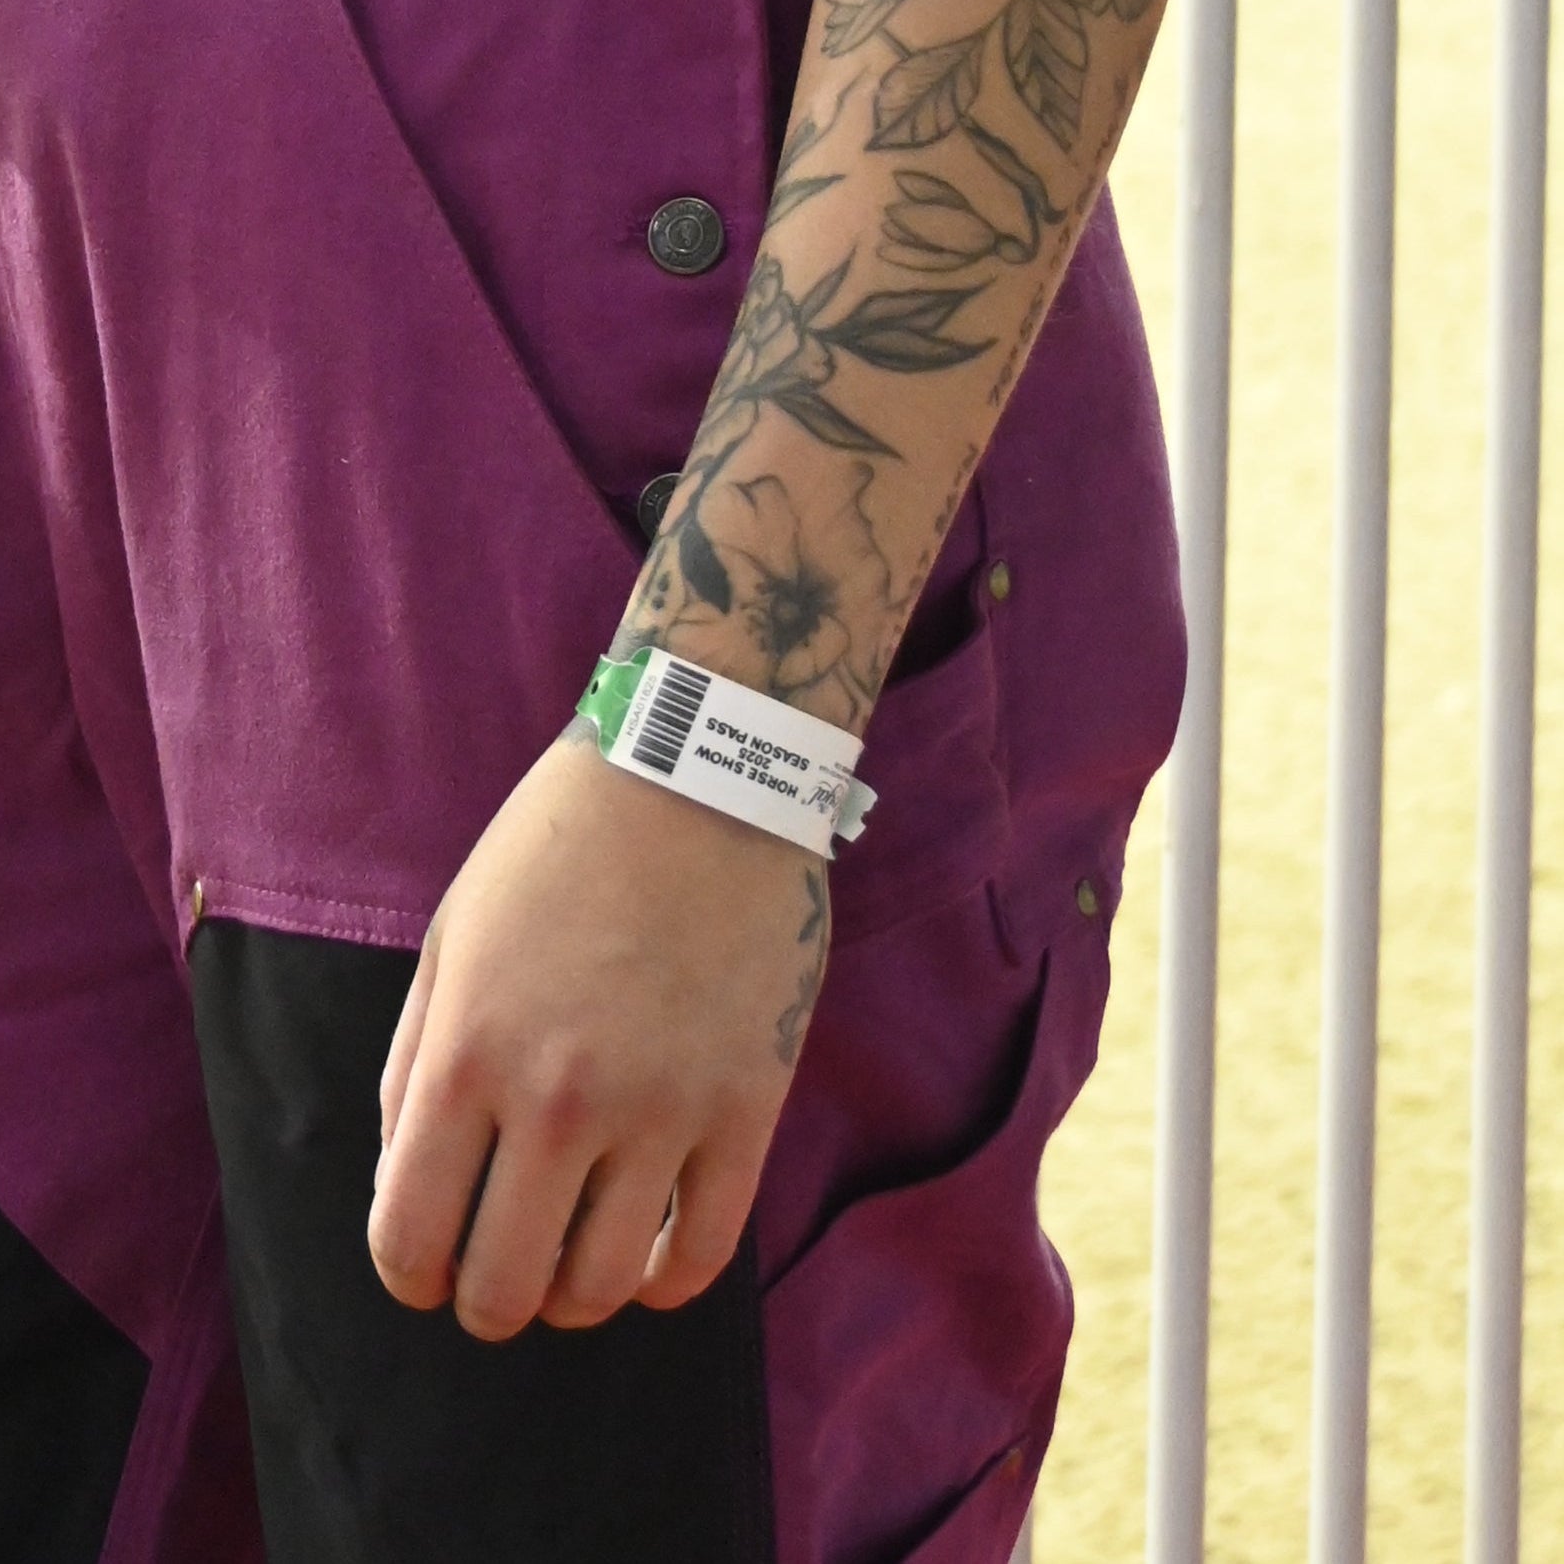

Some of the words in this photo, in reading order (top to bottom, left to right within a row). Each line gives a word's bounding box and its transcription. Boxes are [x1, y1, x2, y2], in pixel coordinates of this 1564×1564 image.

[705, 717, 749, 745] PASS
[694, 745, 746, 775] SHOW
[738, 747, 773, 771] 2025
[749, 736, 811, 772] SEASON
[747, 766, 799, 799] HORSE
